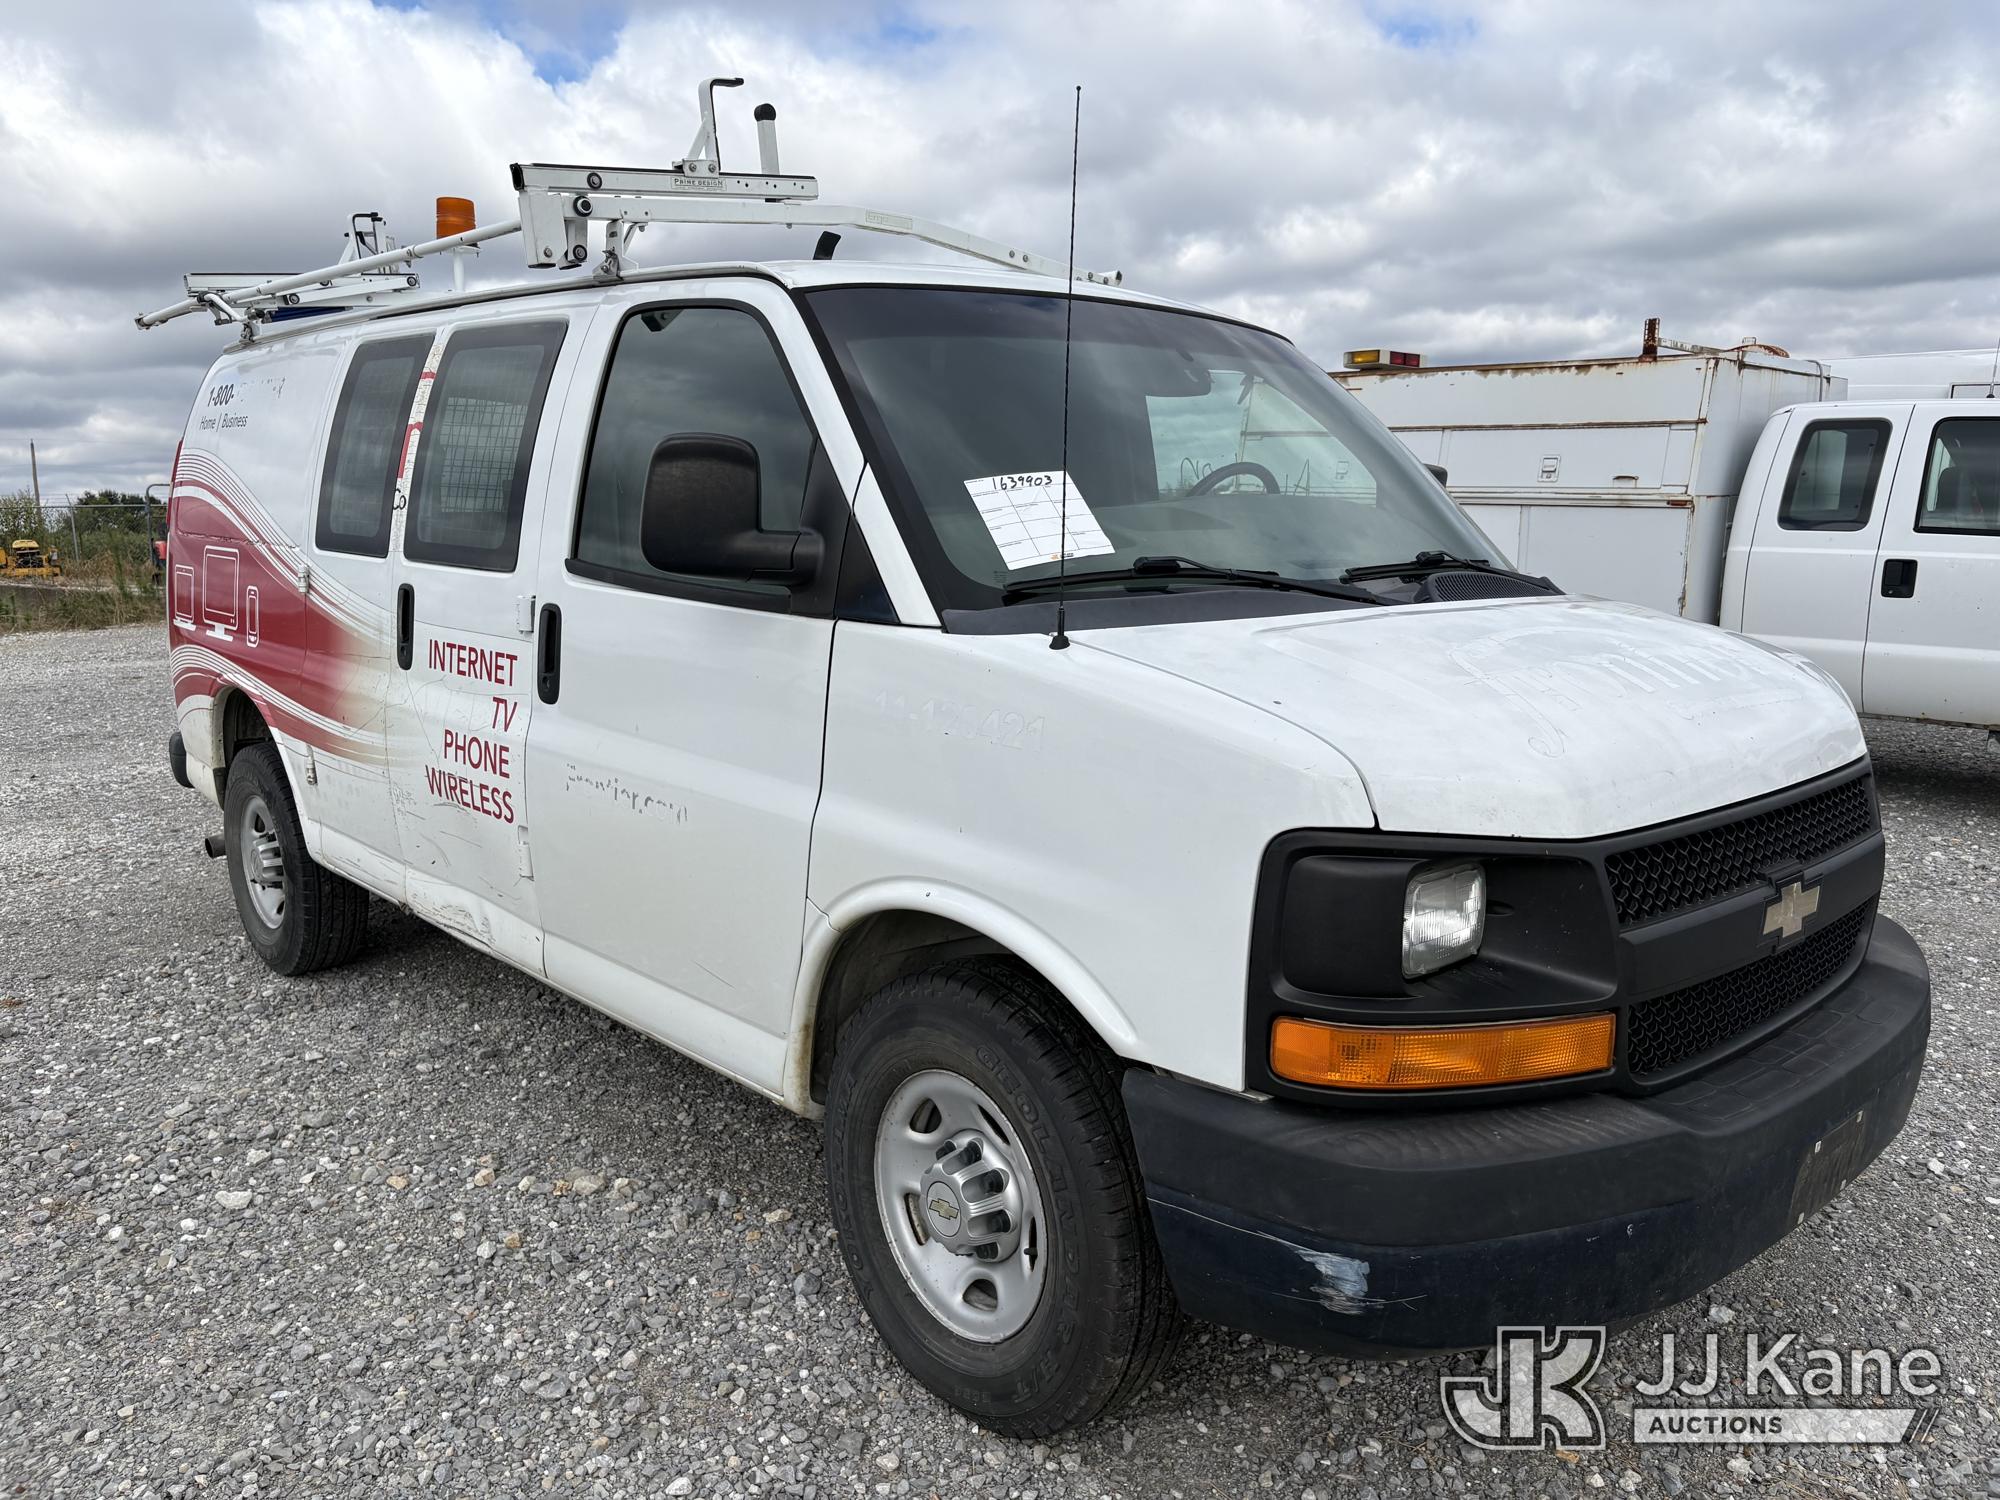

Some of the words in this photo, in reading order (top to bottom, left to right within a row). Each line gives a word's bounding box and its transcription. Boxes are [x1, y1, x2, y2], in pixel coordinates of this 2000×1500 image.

[199, 416, 216, 430] Home
[222, 413, 248, 428] Business
[992, 475, 1053, 490] 1639903
[428, 639, 518, 687] INTERNET
[492, 696, 517, 732] TV
[444, 729, 510, 779] PHONE
[425, 764, 514, 824] WIRELESS
